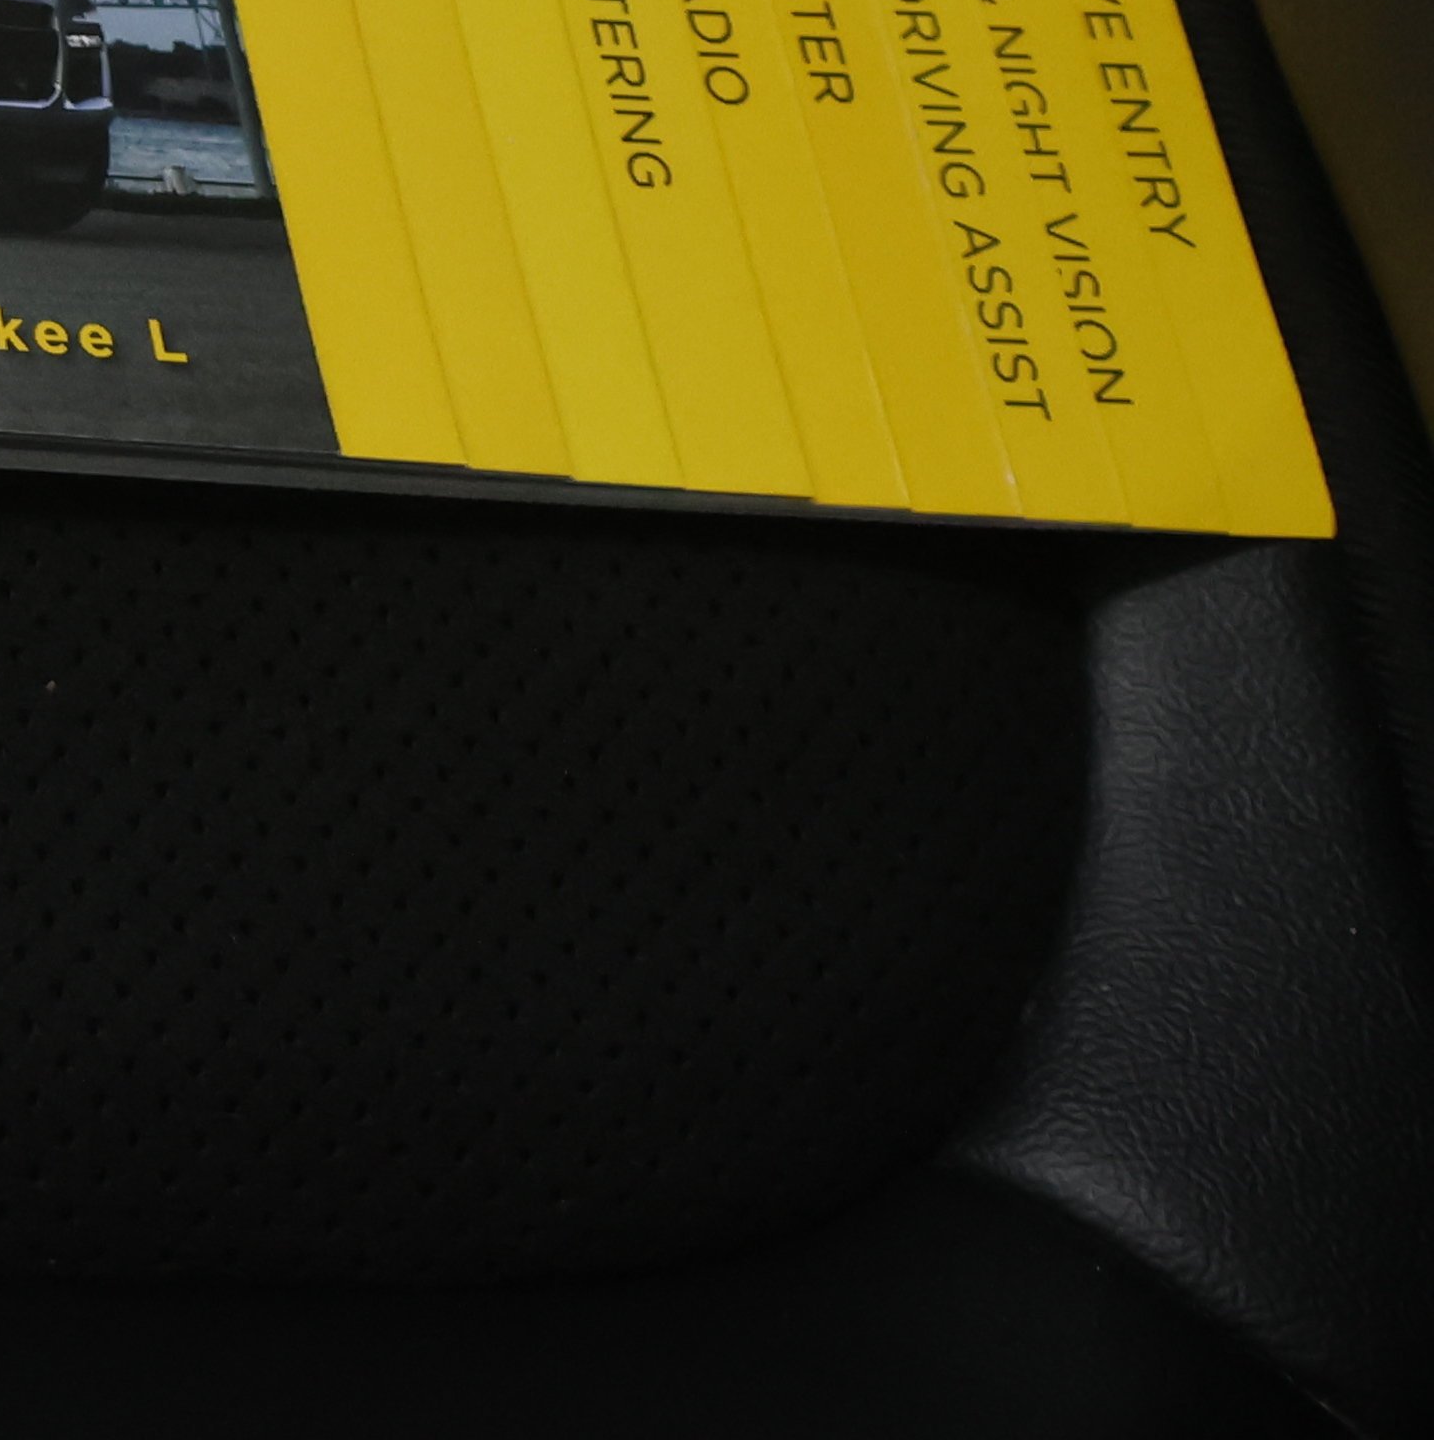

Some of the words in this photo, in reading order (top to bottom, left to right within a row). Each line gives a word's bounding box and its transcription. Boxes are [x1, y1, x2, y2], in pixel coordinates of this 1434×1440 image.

[989, 24, 1069, 193] NIGHT
[1045, 213, 1132, 406] VISION
[1100, 61, 1196, 249] ENTRY
[148, 319, 188, 363] L
[954, 219, 1052, 421] ASSIST
